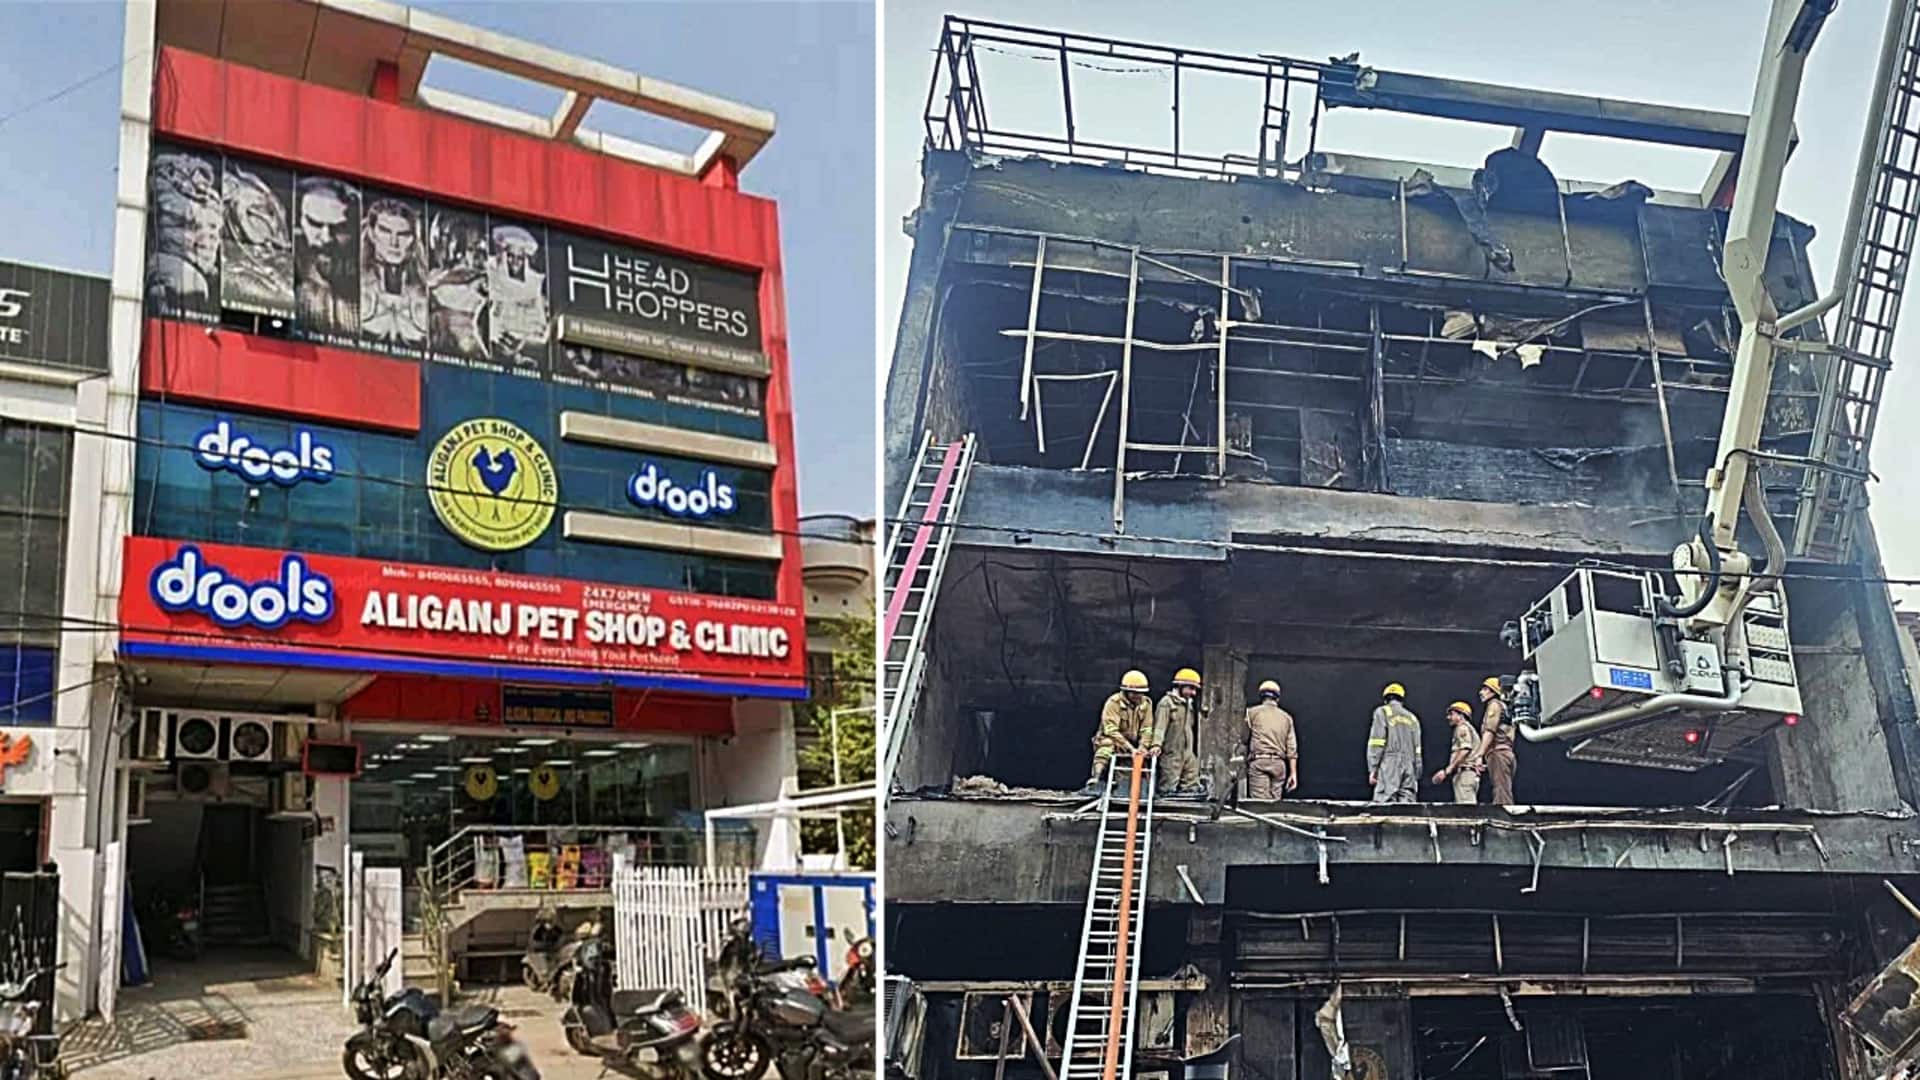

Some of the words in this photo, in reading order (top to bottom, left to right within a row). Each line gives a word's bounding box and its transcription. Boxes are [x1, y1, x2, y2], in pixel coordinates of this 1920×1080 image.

[614, 255, 690, 295] HEAD
[615, 285, 748, 337] HOPPERS
[200, 421, 333, 481] drools
[433, 431, 463, 482] ALIGANJ
[463, 422, 486, 437] PET
[491, 423, 525, 443] SHOP
[533, 453, 554, 498] CLINIC
[635, 463, 734, 514] drools
[156, 551, 329, 623] drools
[583, 598, 650, 613] EMERGENCY
[618, 589, 650, 601] OPEN
[360, 590, 511, 636] ALIGANJ
[517, 604, 579, 640] PET
[585, 610, 665, 647] SHOP
[668, 620, 692, 650] &
[695, 621, 789, 657] CLINIC
[508, 642, 528, 654] For
[533, 643, 599, 661] Everything
[601, 647, 627, 659] Your
